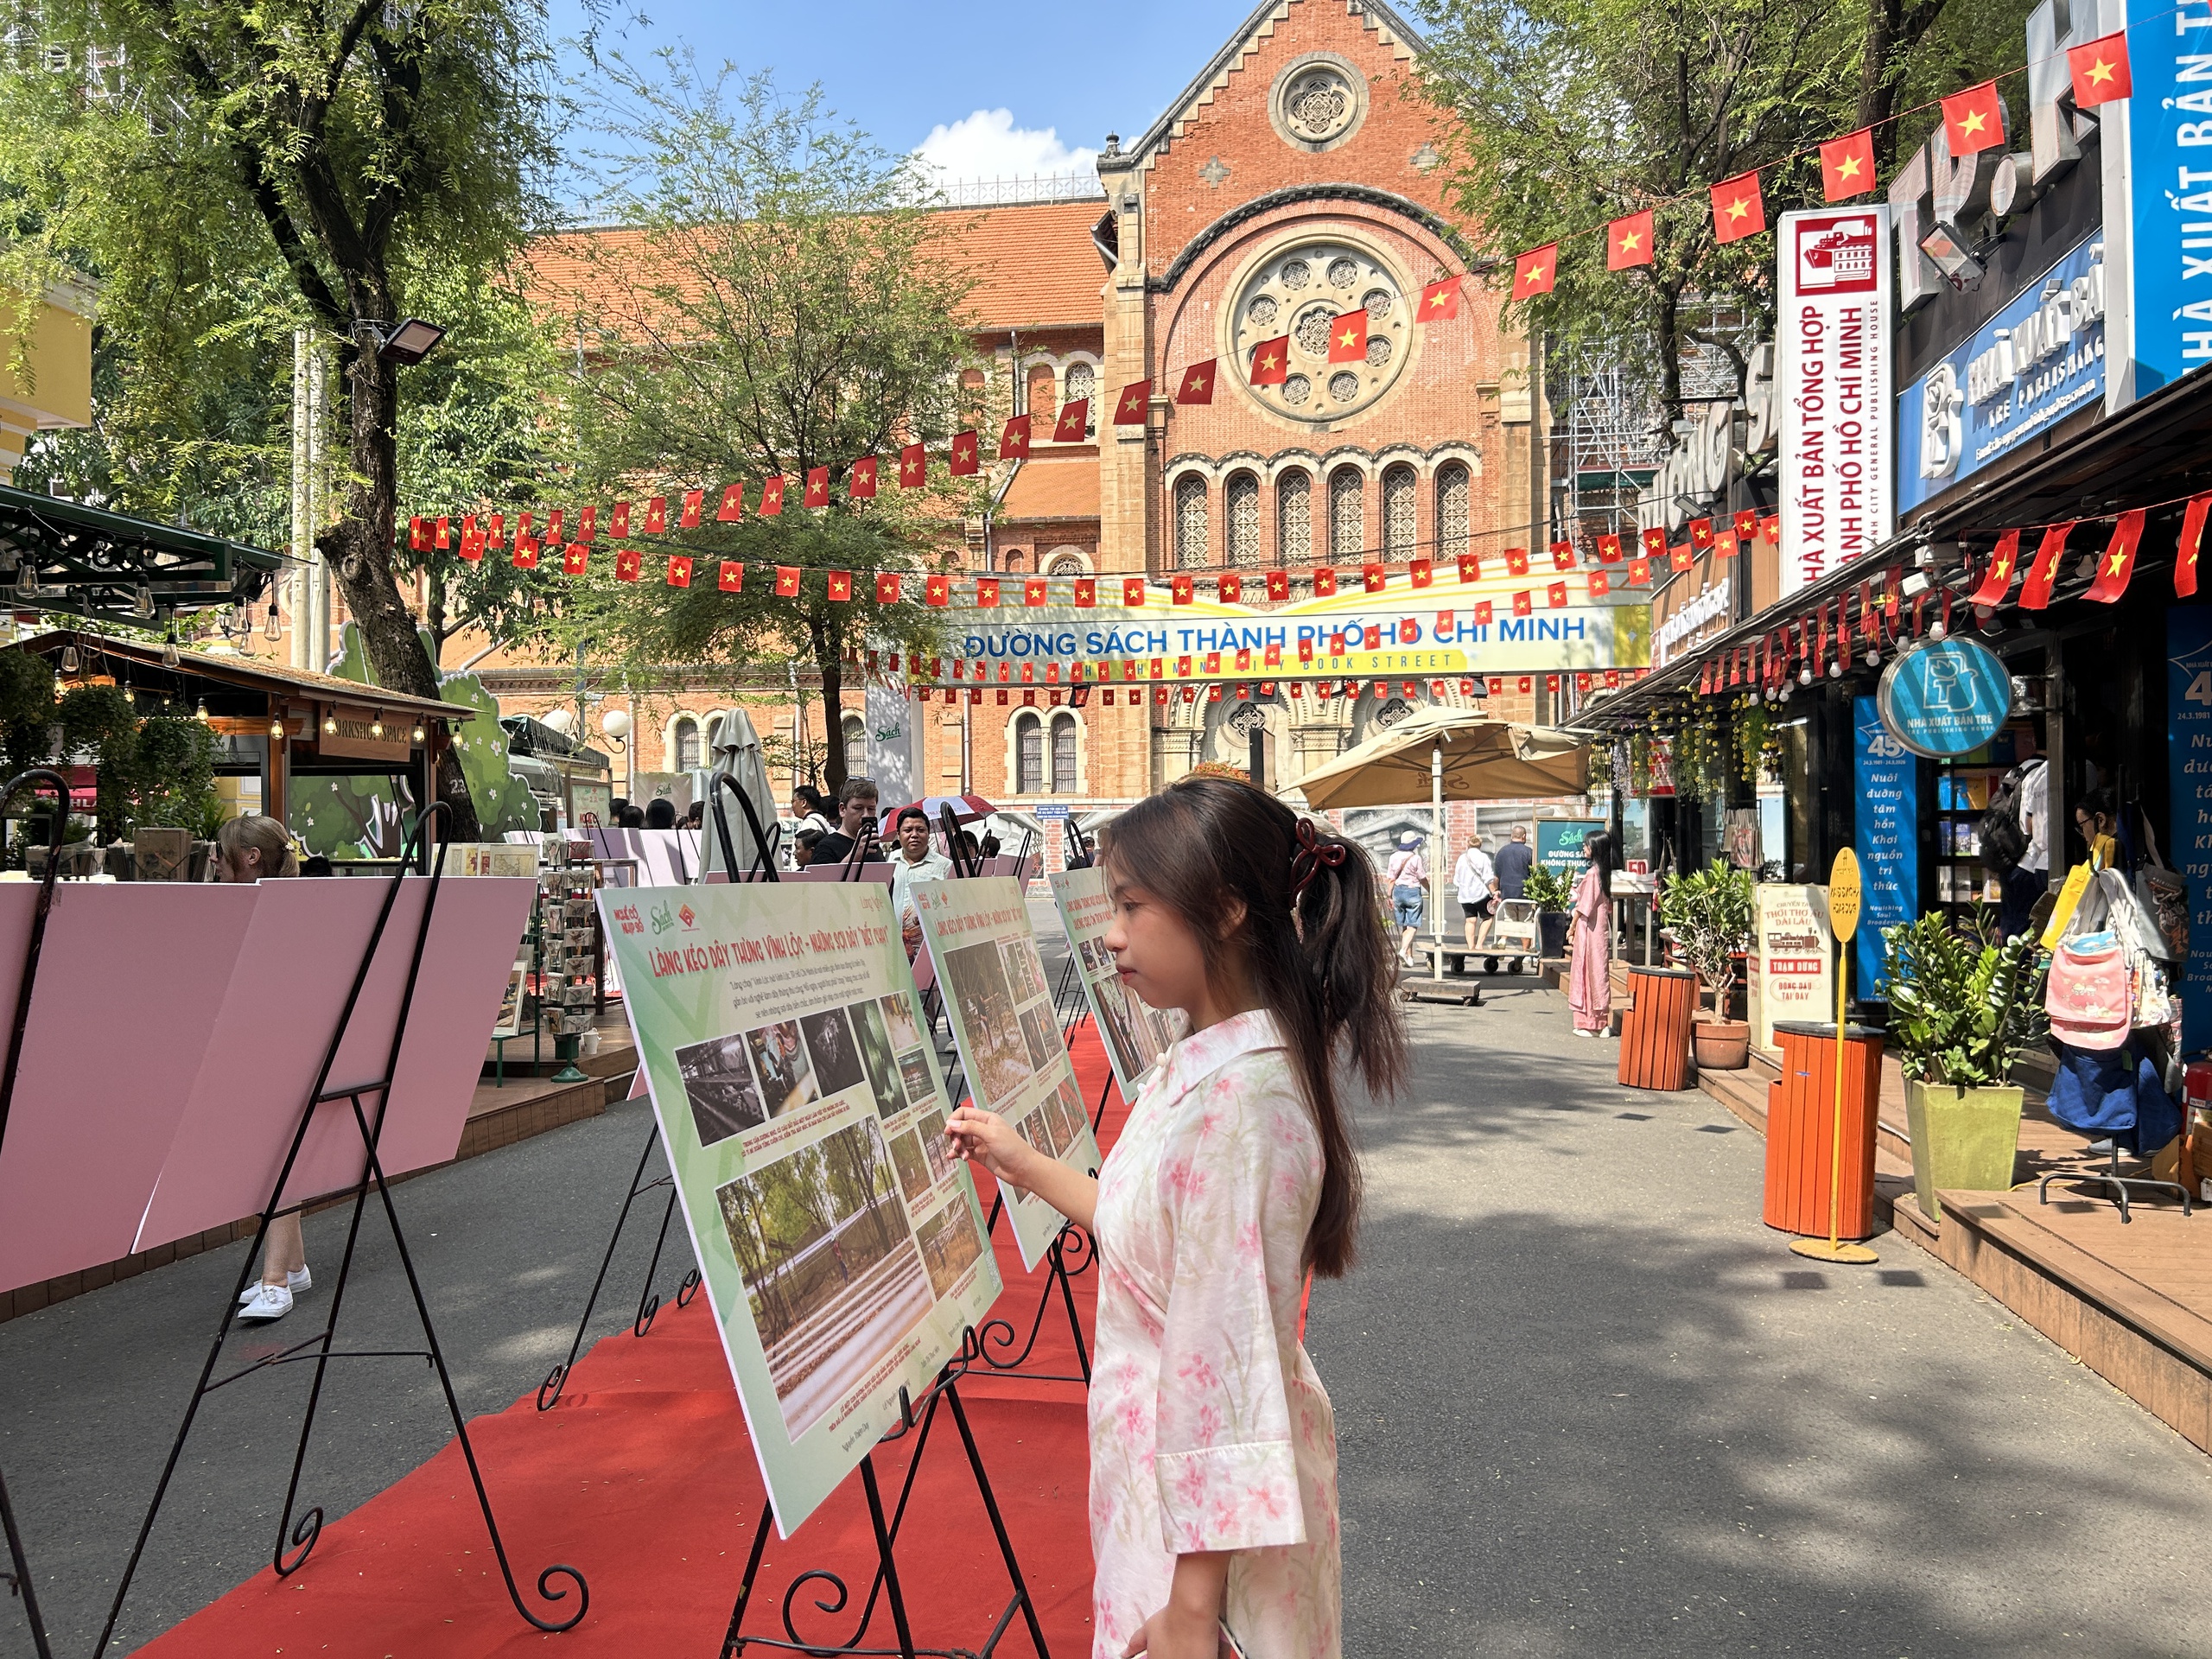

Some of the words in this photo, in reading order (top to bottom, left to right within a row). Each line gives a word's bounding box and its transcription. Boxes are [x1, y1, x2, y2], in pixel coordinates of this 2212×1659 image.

[1799, 305, 1830, 355] HỢP
[1840, 307, 1862, 370] MINH
[2172, 296, 2212, 374] HÀ
[1794, 360, 1824, 427] TỔNG
[1835, 376, 1862, 415] CHÍ
[1832, 421, 1862, 455] HỒ
[1796, 431, 1824, 478] BẢN
[1832, 461, 1862, 511] PHỐ
[1797, 485, 1825, 543] XUẤT
[1798, 550, 1825, 588] HÀ
[964, 627, 1077, 658] ĐƯỜNG
[1085, 625, 1167, 654] SÁCH
[1177, 621, 1287, 652] THÀNH
[1297, 618, 1364, 647] PHỐ
[1499, 617, 1585, 642] MINH
[1303, 657, 1353, 671] BOOK
[1372, 654, 1451, 668] STREET
[1907, 716, 1927, 728] NHÀ
[1929, 714, 1952, 727] XUẤT
[1955, 713, 1974, 726] BẢN
[1975, 712, 1993, 724] TRẺ
[2177, 711, 2210, 720] 24.3.1981
[327, 719, 378, 741] ORKSHO
[382, 724, 407, 744] SPACE
[875, 721, 901, 741] Sách
[1867, 735, 1900, 757] 45
[449, 779, 466, 794] 23
[1871, 773, 1897, 783] Nuôi
[1866, 788, 1902, 800] dưỡng
[1873, 804, 1896, 814] tâm
[1874, 819, 1895, 830] hồn
[1559, 828, 1583, 846] Sách
[1872, 834, 1897, 844] Khơi
[1541, 858, 1566, 867] KHÔNG
[1867, 849, 1903, 862] nguồn
[1878, 866, 1892, 875] trí
[1873, 880, 1898, 891] thức
[651, 899, 674, 935] Sách
[649, 946, 685, 977] LÀNG
[682, 943, 709, 972] KÉO
[708, 938, 732, 969] DÂY
[730, 937, 766, 966] THỪNG
[762, 934, 788, 961] VĨNH
[784, 931, 804, 960] LỘC
